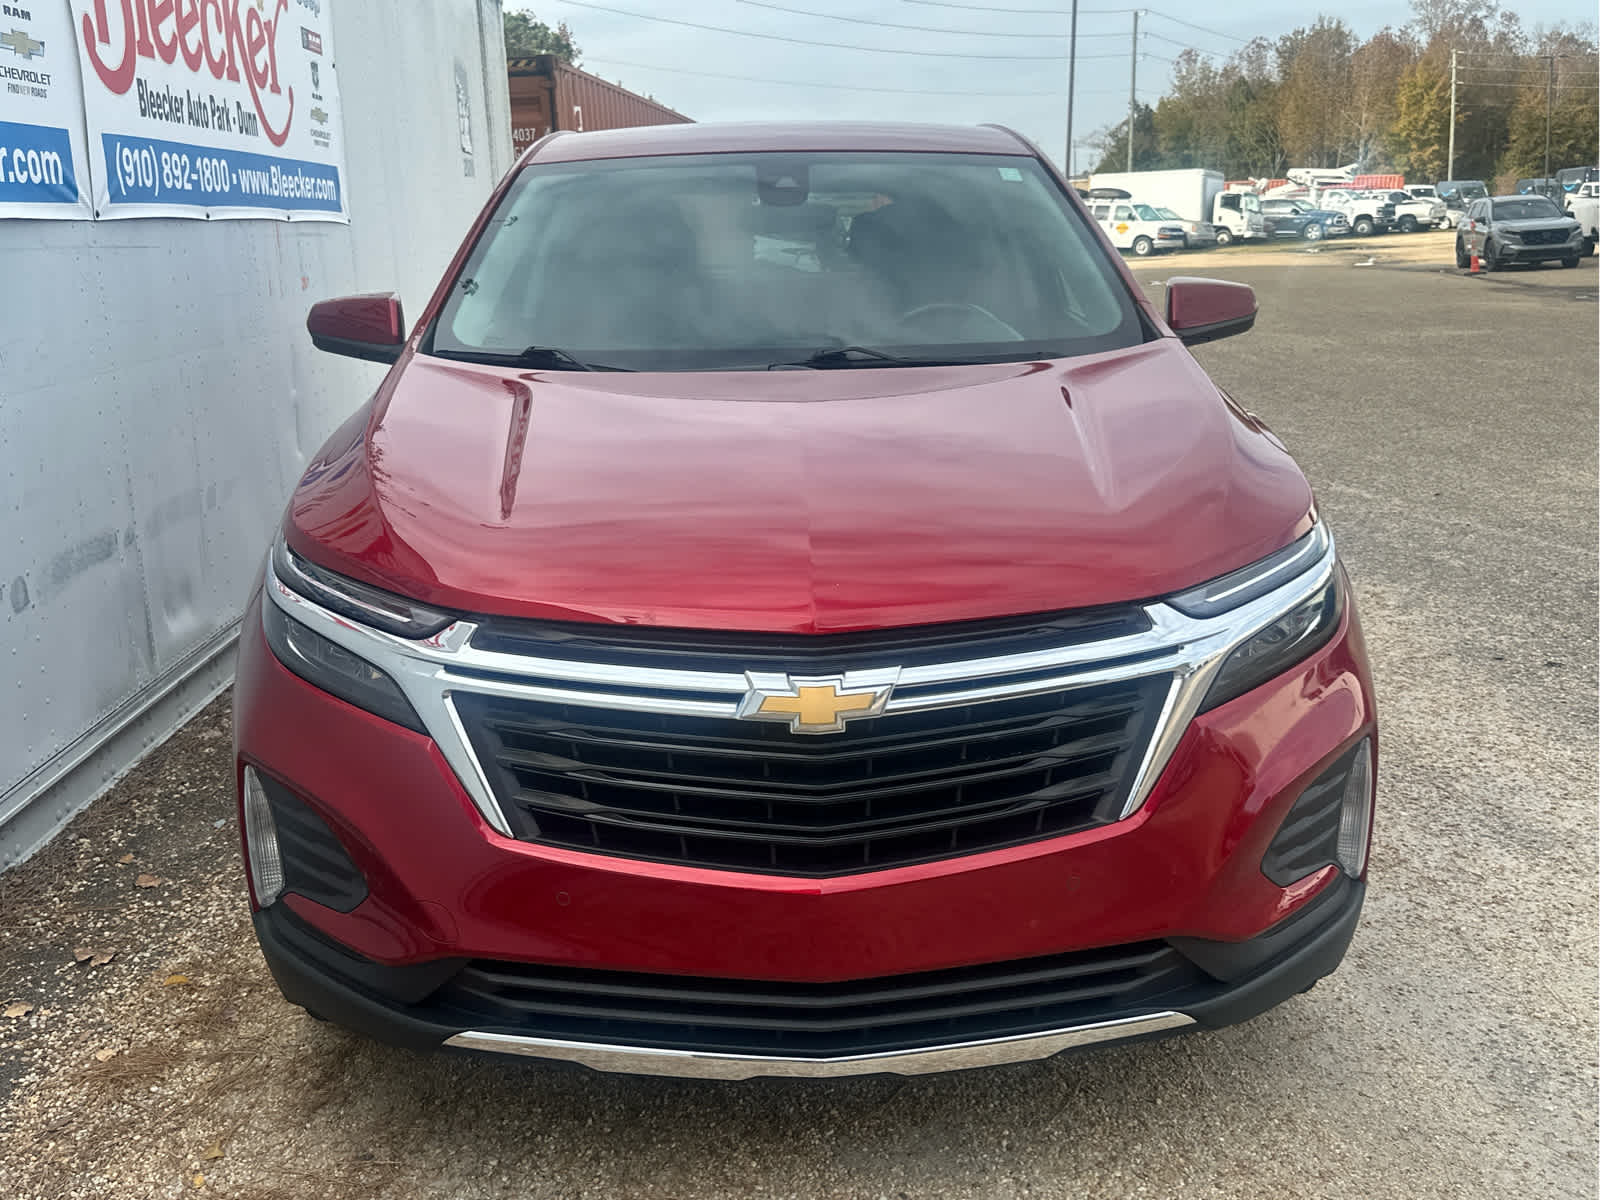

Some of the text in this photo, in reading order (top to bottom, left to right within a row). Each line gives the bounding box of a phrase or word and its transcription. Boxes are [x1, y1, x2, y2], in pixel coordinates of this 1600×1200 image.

[3, 5, 31, 21] RAM
[0, 65, 51, 86] CHEVROLET
[31, 86, 48, 99] ROADS
[136, 77, 259, 137] Bleecker Auto Park Dunn
[115, 141, 337, 201] (910) 892-1800 www.Bleecker.com
